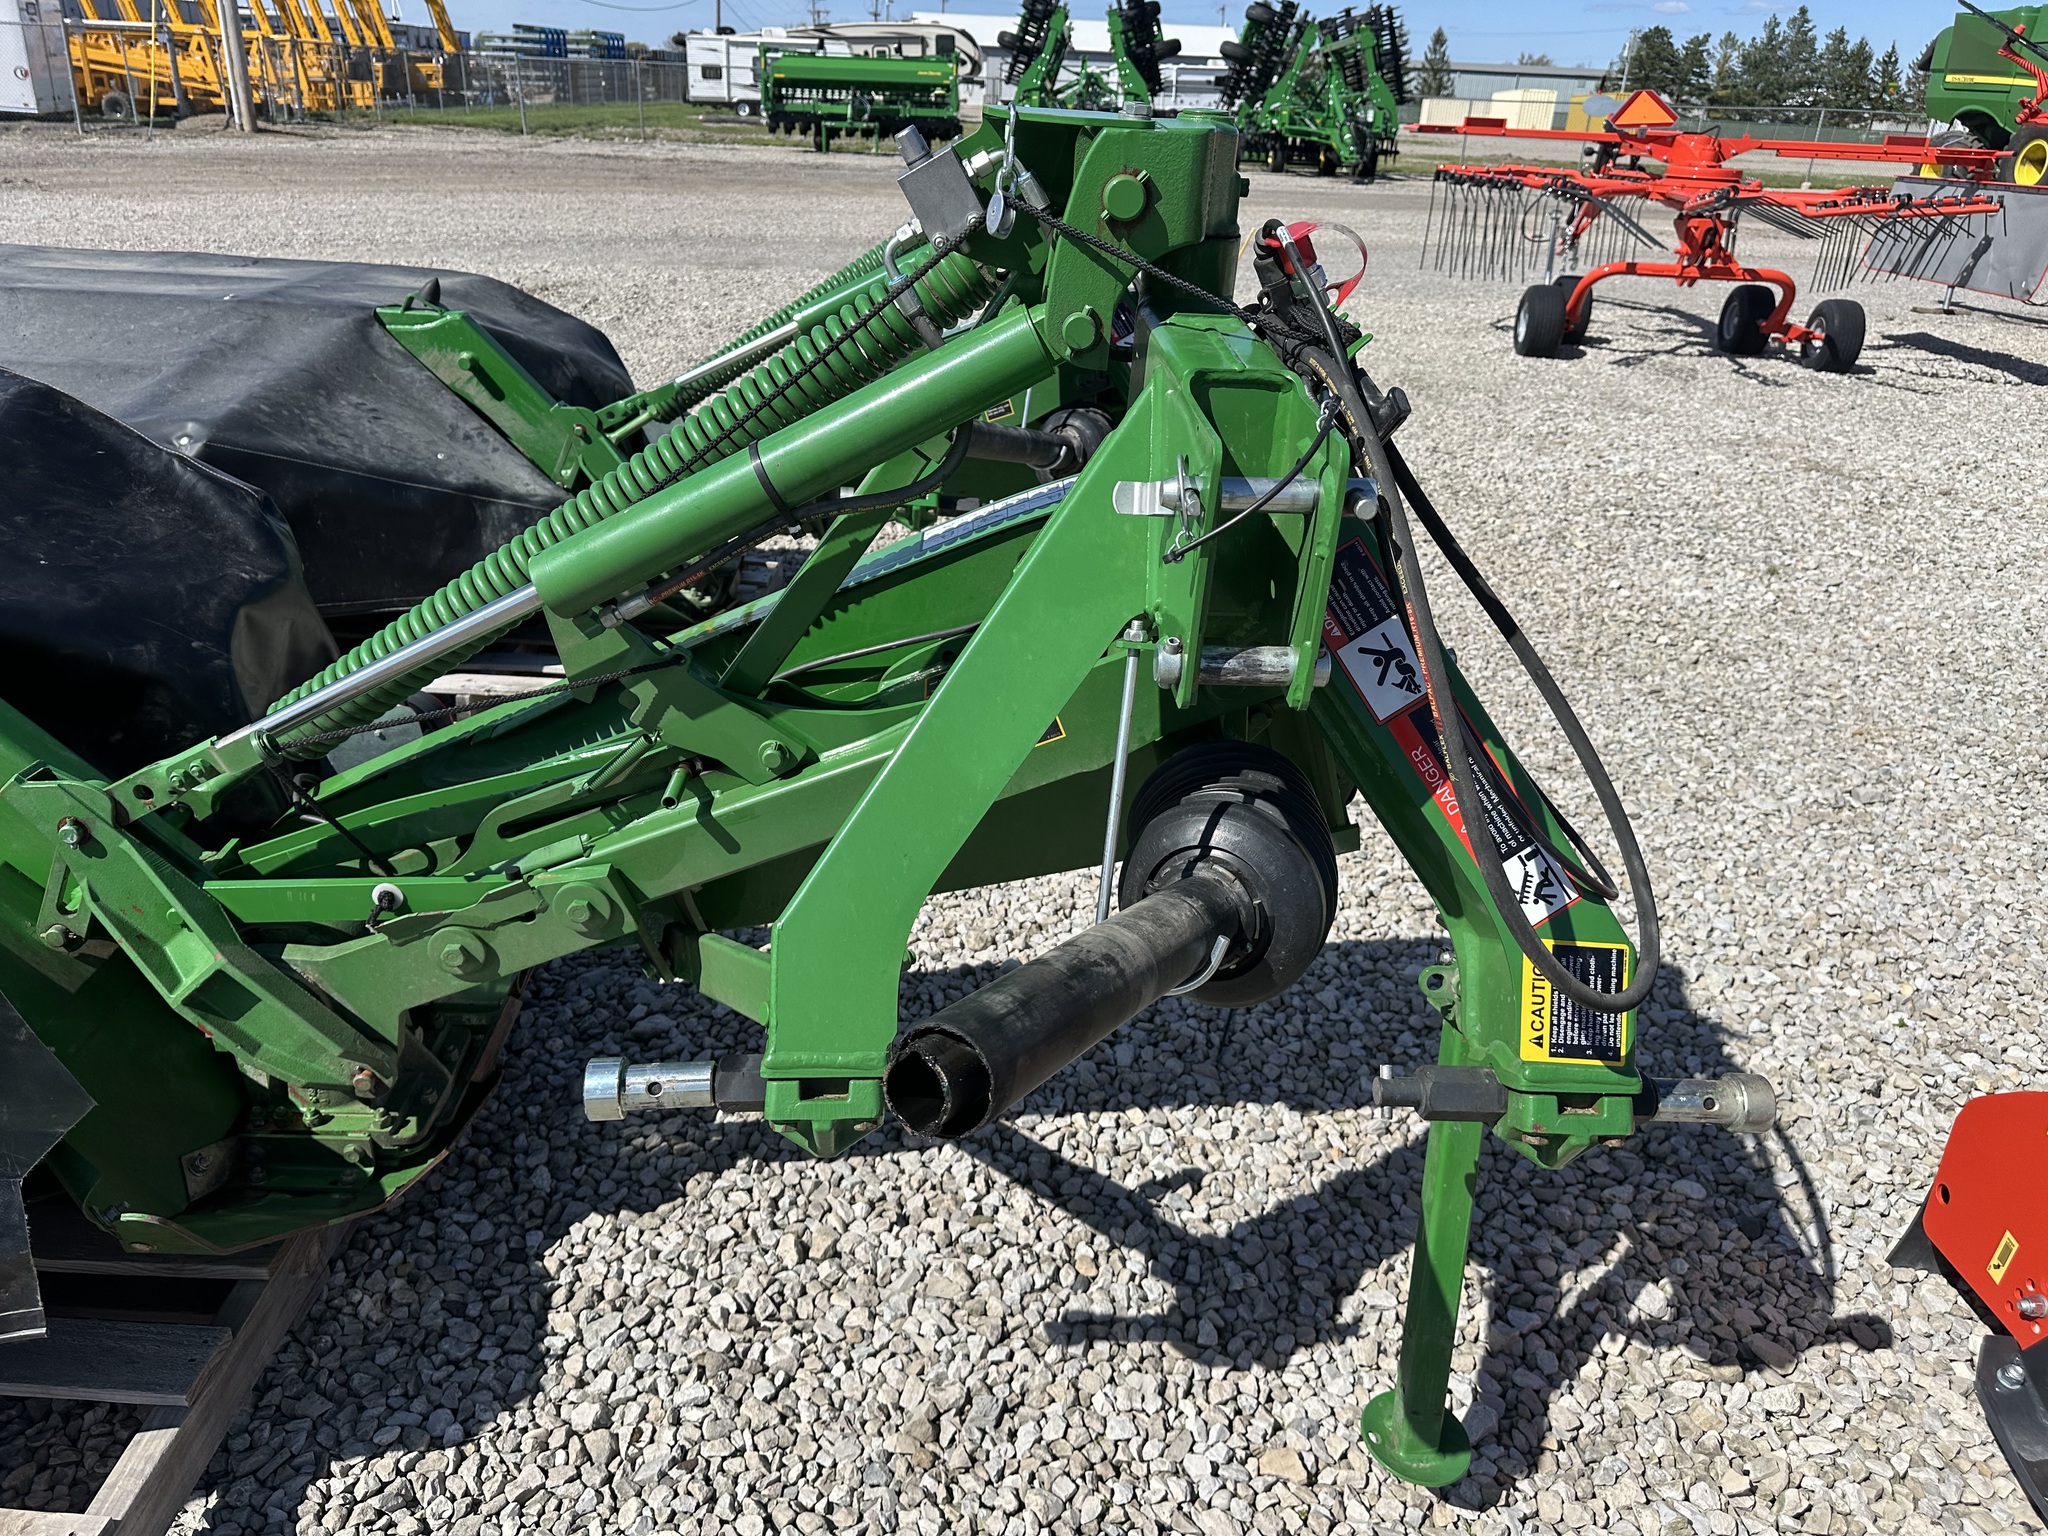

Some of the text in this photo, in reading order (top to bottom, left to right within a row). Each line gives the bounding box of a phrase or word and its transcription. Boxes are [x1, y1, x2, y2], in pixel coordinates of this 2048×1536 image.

[1351, 581, 1366, 601] shields
[1359, 567, 1390, 614] Avoid contact with
[1371, 574, 1396, 610] rotating parts.
[1338, 599, 1347, 610] can
[1367, 606, 1379, 621] Keep
[1331, 600, 1356, 636] Entanglement
[1344, 609, 1361, 632] driveline
[1354, 612, 1367, 628] injury
[1412, 633, 1428, 674] PREMIUM
[1425, 681, 1438, 717] BALPAC
[1438, 734, 1452, 769] BALFLEX
[1409, 745, 1461, 815] DANGER
[1477, 790, 1493, 810] when
[1489, 809, 1512, 839] machine
[1498, 842, 1509, 853] To
[1507, 838, 1517, 848] of
[1530, 965, 1545, 1031] CAUTI
[1608, 1037, 1614, 1046] Do
